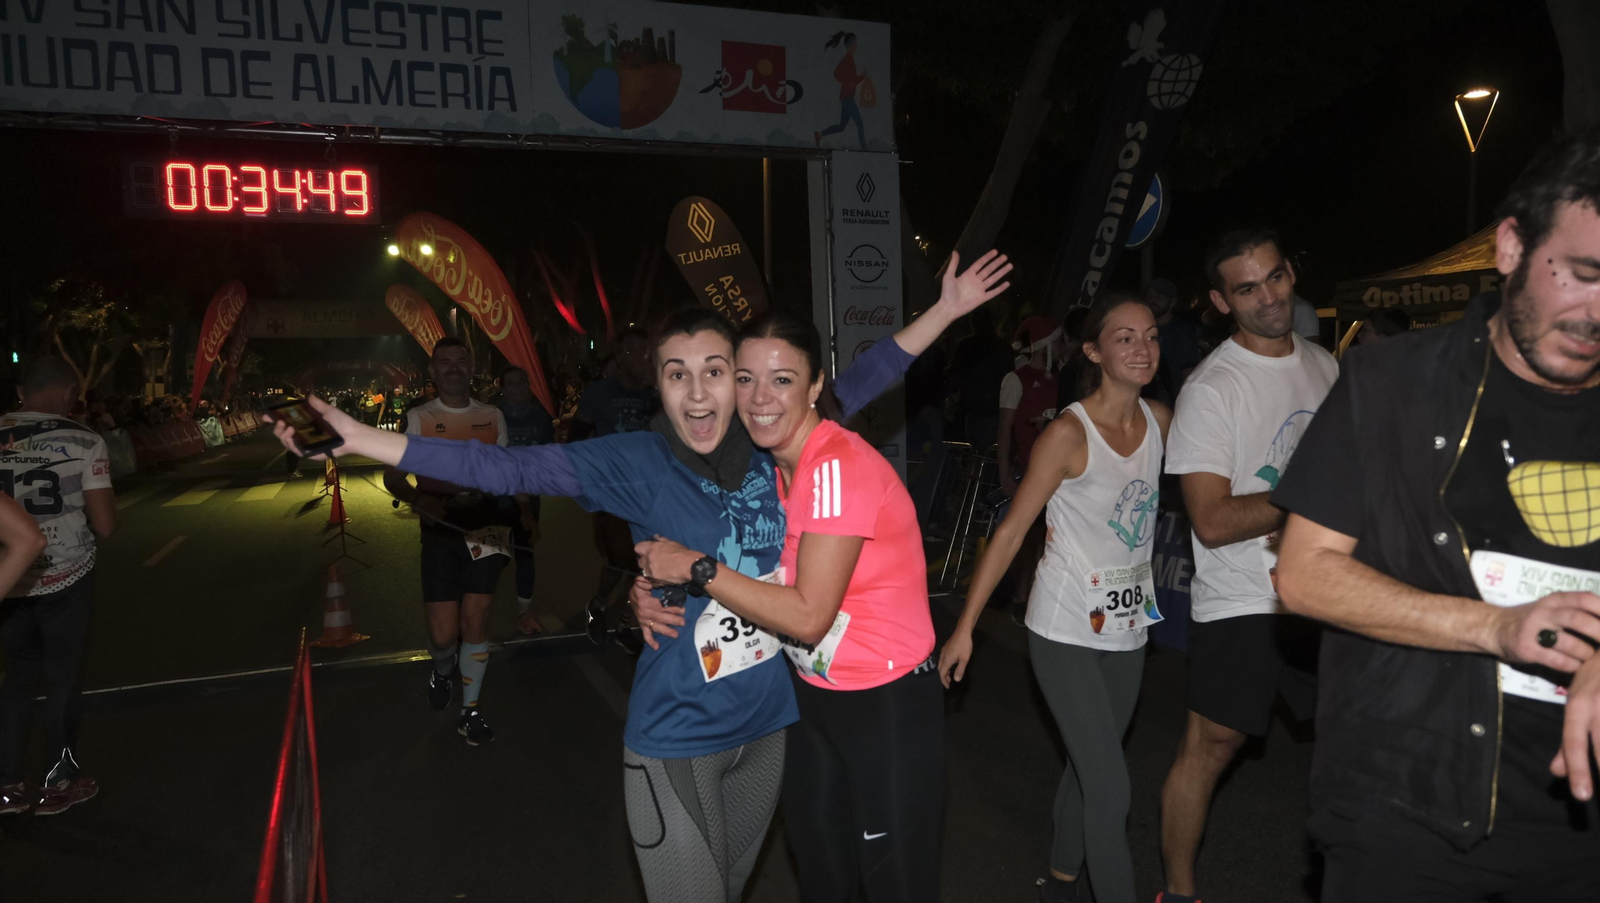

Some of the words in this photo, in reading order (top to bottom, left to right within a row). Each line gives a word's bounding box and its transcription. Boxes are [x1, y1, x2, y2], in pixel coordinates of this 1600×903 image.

[73, 0, 197, 35] SAN
[215, 0, 505, 57] SILVESTRE
[1, 33, 182, 95] IUDAD
[201, 47, 273, 101] DE
[292, 53, 517, 112] ALMERÍA
[165, 163, 368, 216] 00:34:49
[842, 208, 890, 218] RENAULT
[845, 259, 890, 268] NISSAN
[1362, 283, 1470, 308] Optima
[0, 432, 73, 459] dalucía
[1106, 585, 1143, 611] 308
[719, 617, 765, 642] 39
